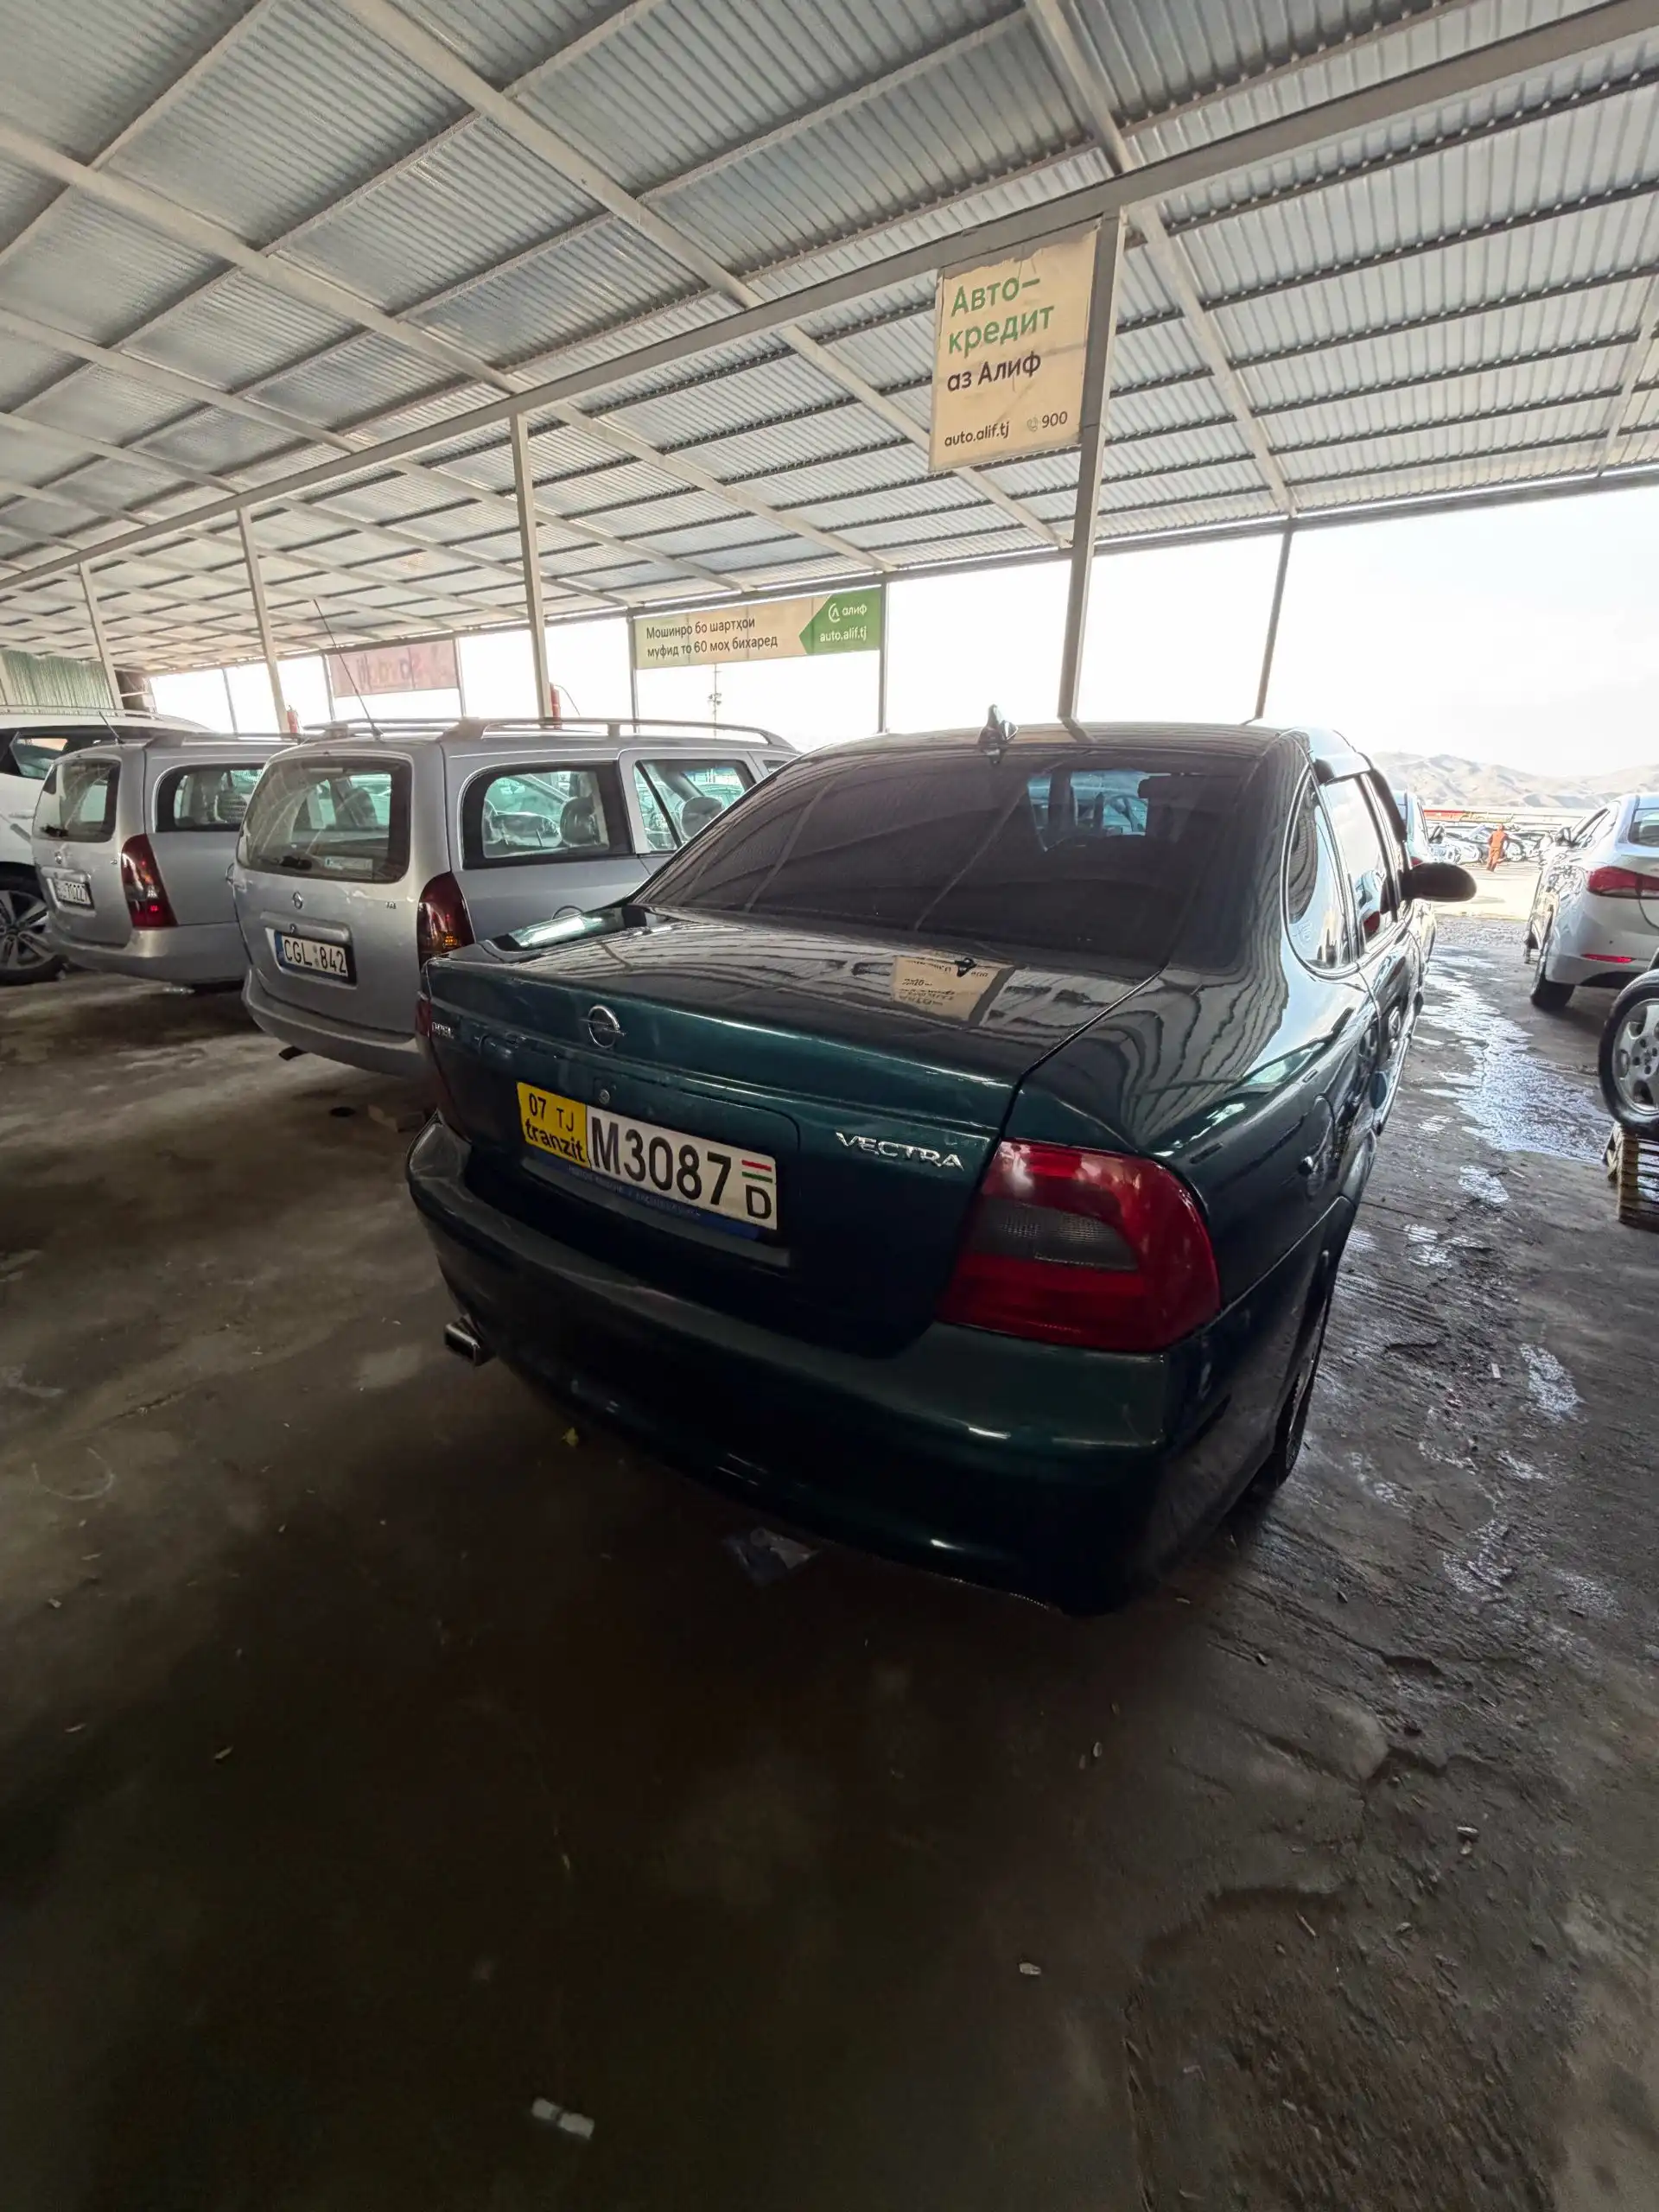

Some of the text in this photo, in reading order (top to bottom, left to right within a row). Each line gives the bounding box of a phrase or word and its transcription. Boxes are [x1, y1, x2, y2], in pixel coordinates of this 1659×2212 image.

[949, 306, 1054, 358] кредит
[947, 350, 1041, 392] аз Алиф
[944, 410, 1068, 447] auto.alif.tj 900
[842, 604, 868, 616] алиф
[646, 625, 693, 640] Мошинро
[695, 621, 708, 634] бо
[647, 644, 679, 660] муфид
[681, 645, 692, 654] то
[694, 639, 708, 653] 60
[732, 636, 779, 651] бихаред
[820, 626, 868, 643] auto.alif.tj
[283, 938, 346, 974] CGL 842
[529, 1092, 575, 1132] 07 TJ
[524, 1119, 585, 1163] tranzit
[835, 1131, 965, 1172] VECTRA
[591, 1116, 732, 1205] M3087
[745, 1184, 772, 1220] D
